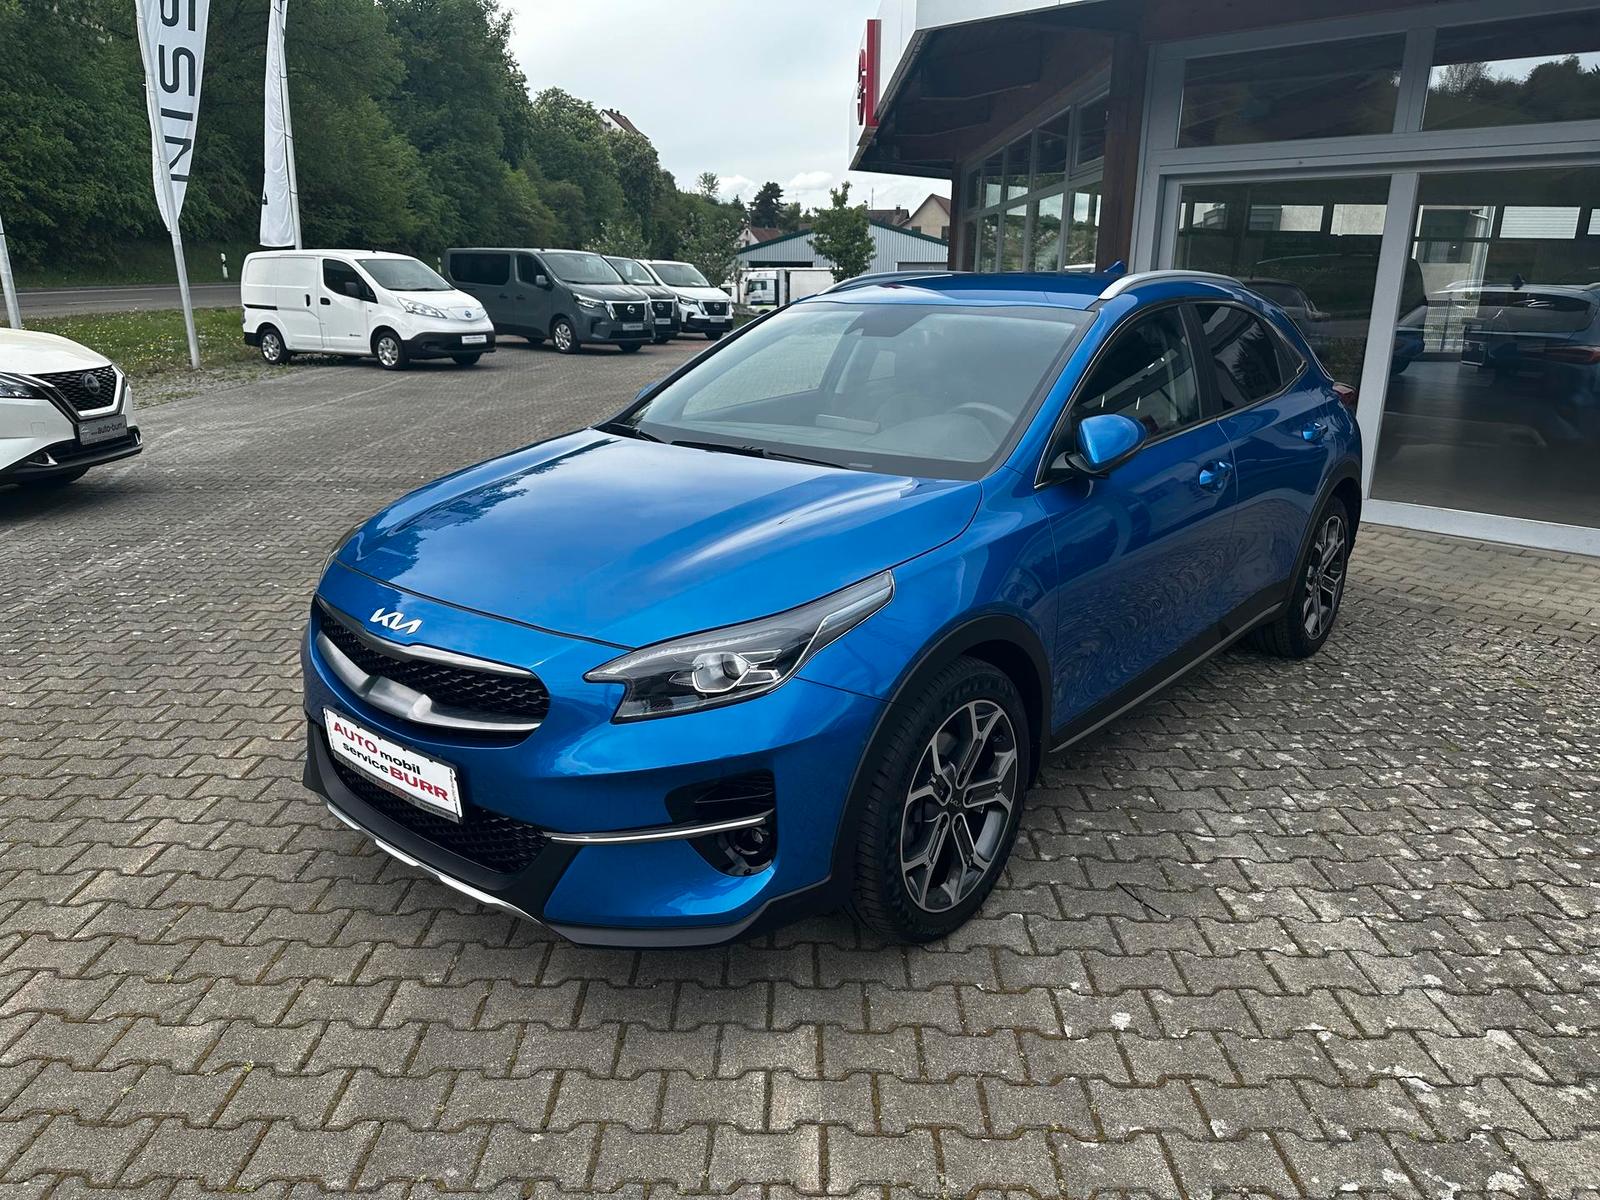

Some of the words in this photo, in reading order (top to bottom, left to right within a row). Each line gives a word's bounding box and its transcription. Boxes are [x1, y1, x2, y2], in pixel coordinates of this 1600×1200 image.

[370, 607, 423, 635] KIA
[333, 722, 378, 754] AUTO
[379, 750, 421, 776] mobil
